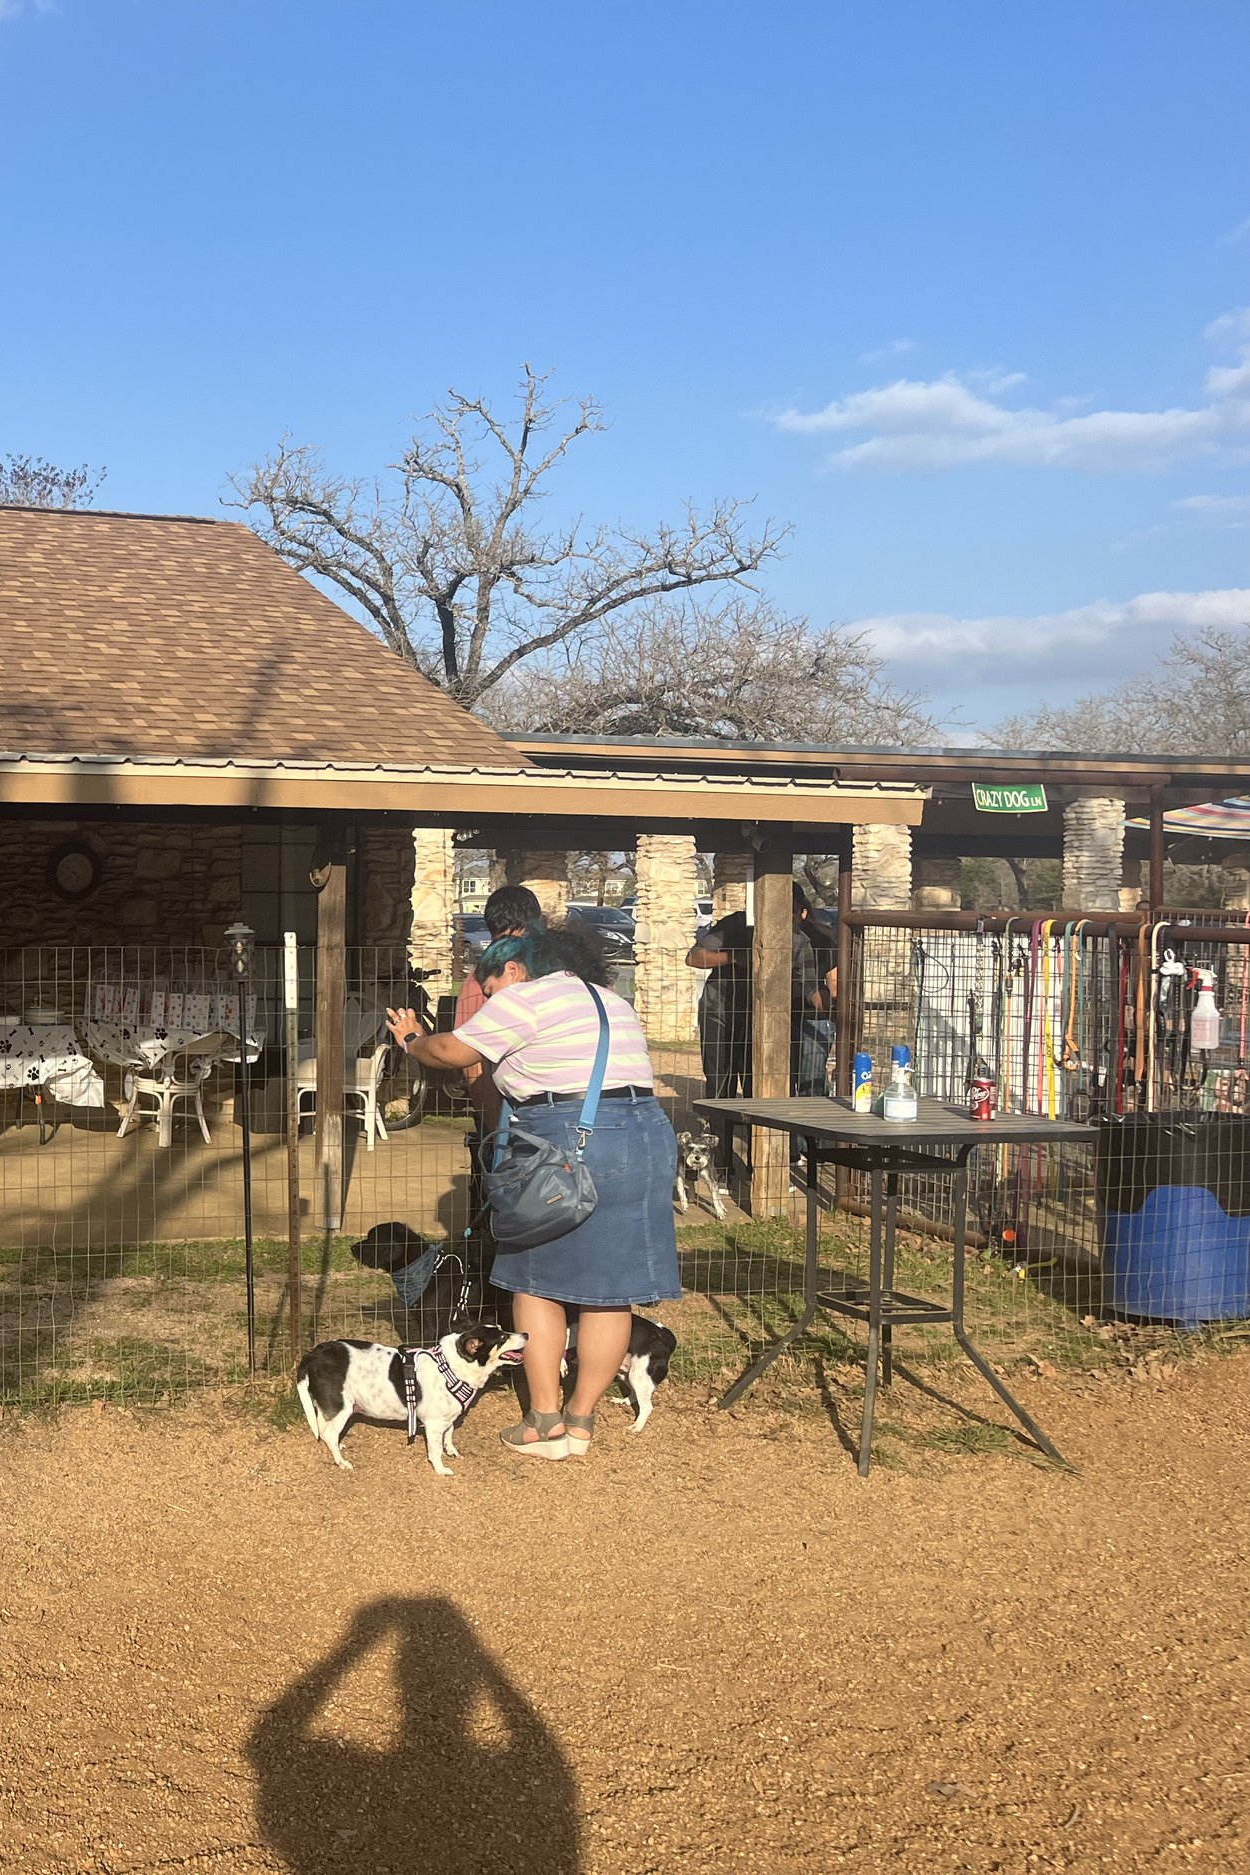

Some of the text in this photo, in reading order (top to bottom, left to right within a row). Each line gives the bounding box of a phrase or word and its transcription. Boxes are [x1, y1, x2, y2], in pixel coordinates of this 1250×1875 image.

[976, 789, 1042, 807] CRAZY DOG LN
